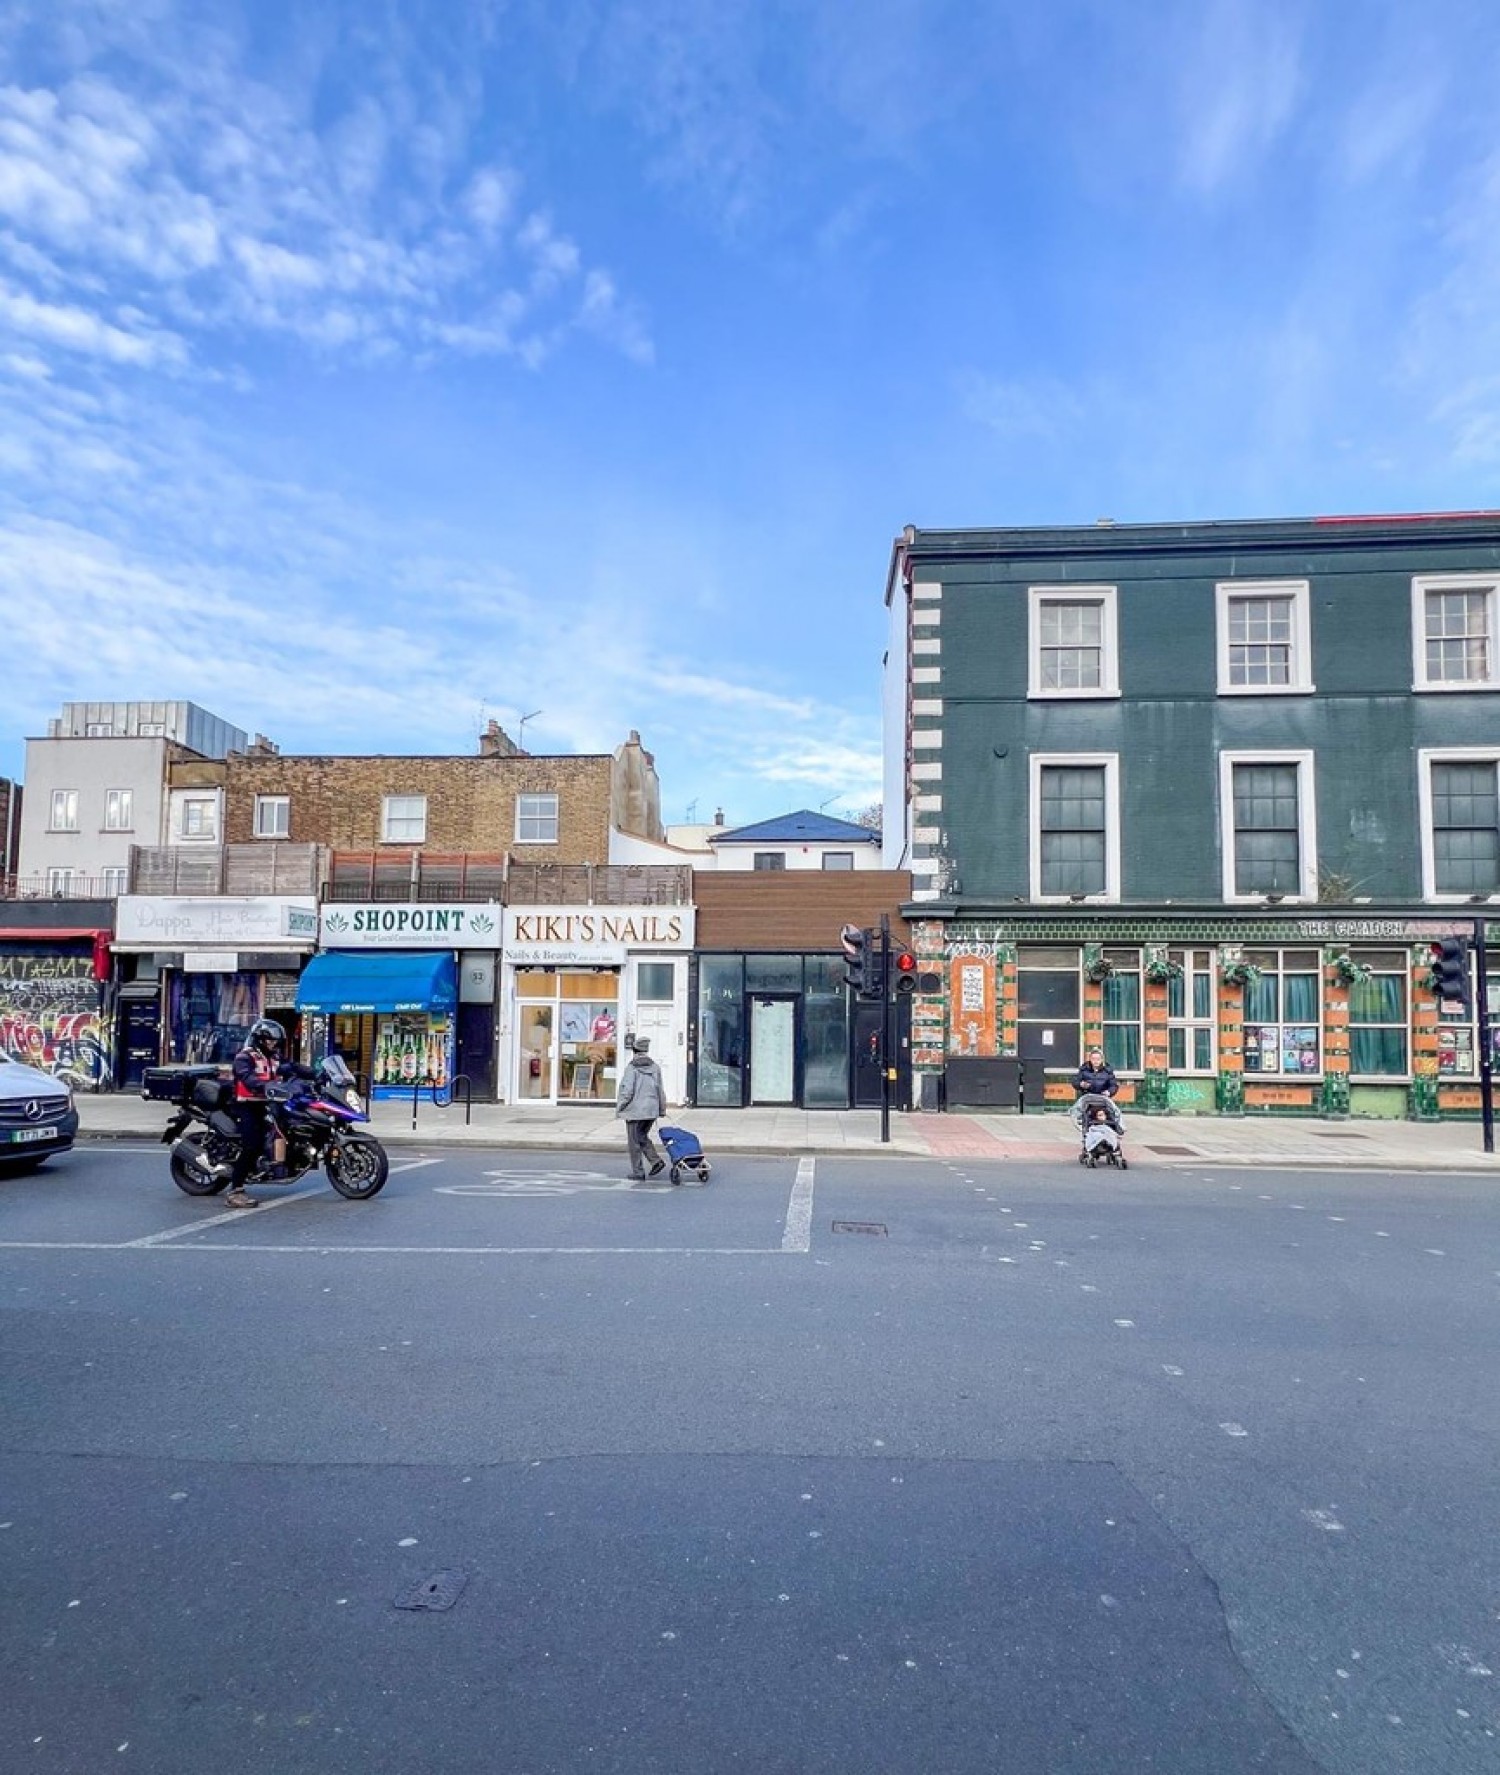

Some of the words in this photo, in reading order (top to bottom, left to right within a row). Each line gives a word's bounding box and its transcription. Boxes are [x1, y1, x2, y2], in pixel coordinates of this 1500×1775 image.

[137, 903, 191, 936] Dappa
[353, 909, 465, 932] SHOPOINT
[515, 915, 595, 942] KIKI'S
[601, 915, 682, 942] NAILS
[1298, 920, 1329, 936] THE
[378, 934, 395, 942] Local
[505, 950, 530, 960] Nails
[532, 950, 542, 960] &
[543, 950, 578, 962] Beauty
